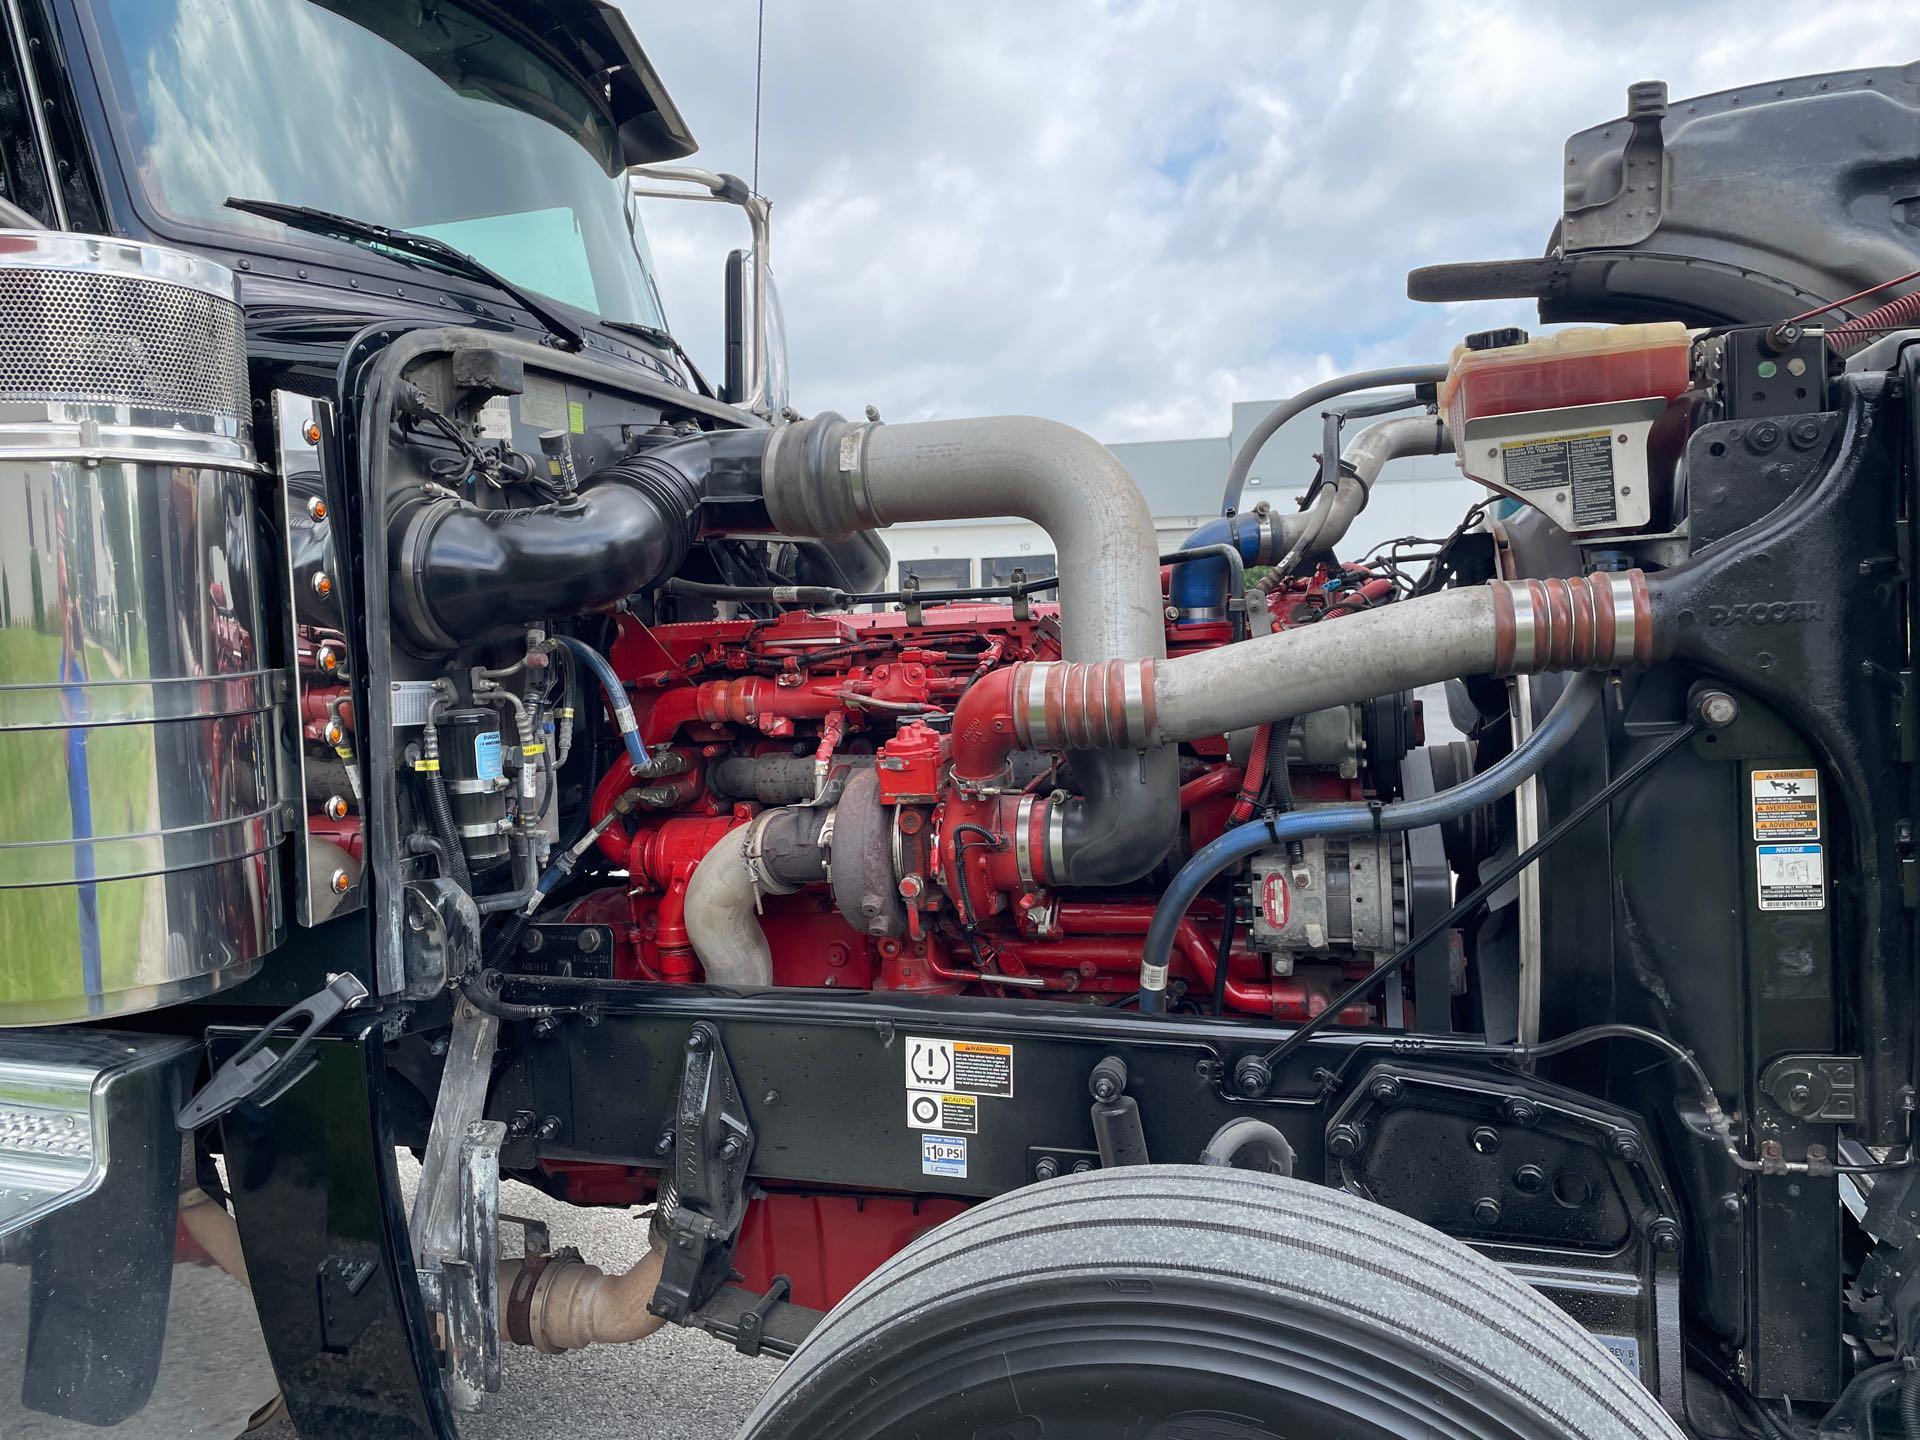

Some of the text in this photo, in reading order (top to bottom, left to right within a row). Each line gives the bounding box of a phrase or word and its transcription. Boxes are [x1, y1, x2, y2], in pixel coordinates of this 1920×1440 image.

[1186, 518, 1198, 527] 12
[933, 545, 939, 554] 9
[1019, 543, 1031, 552] 10
[1768, 821, 1814, 829] ADVERTENCIA
[925, 1144, 963, 1160] 110 PSI
[1609, 1347, 1635, 1358] REV B
[1628, 1359, 1635, 1368] A
